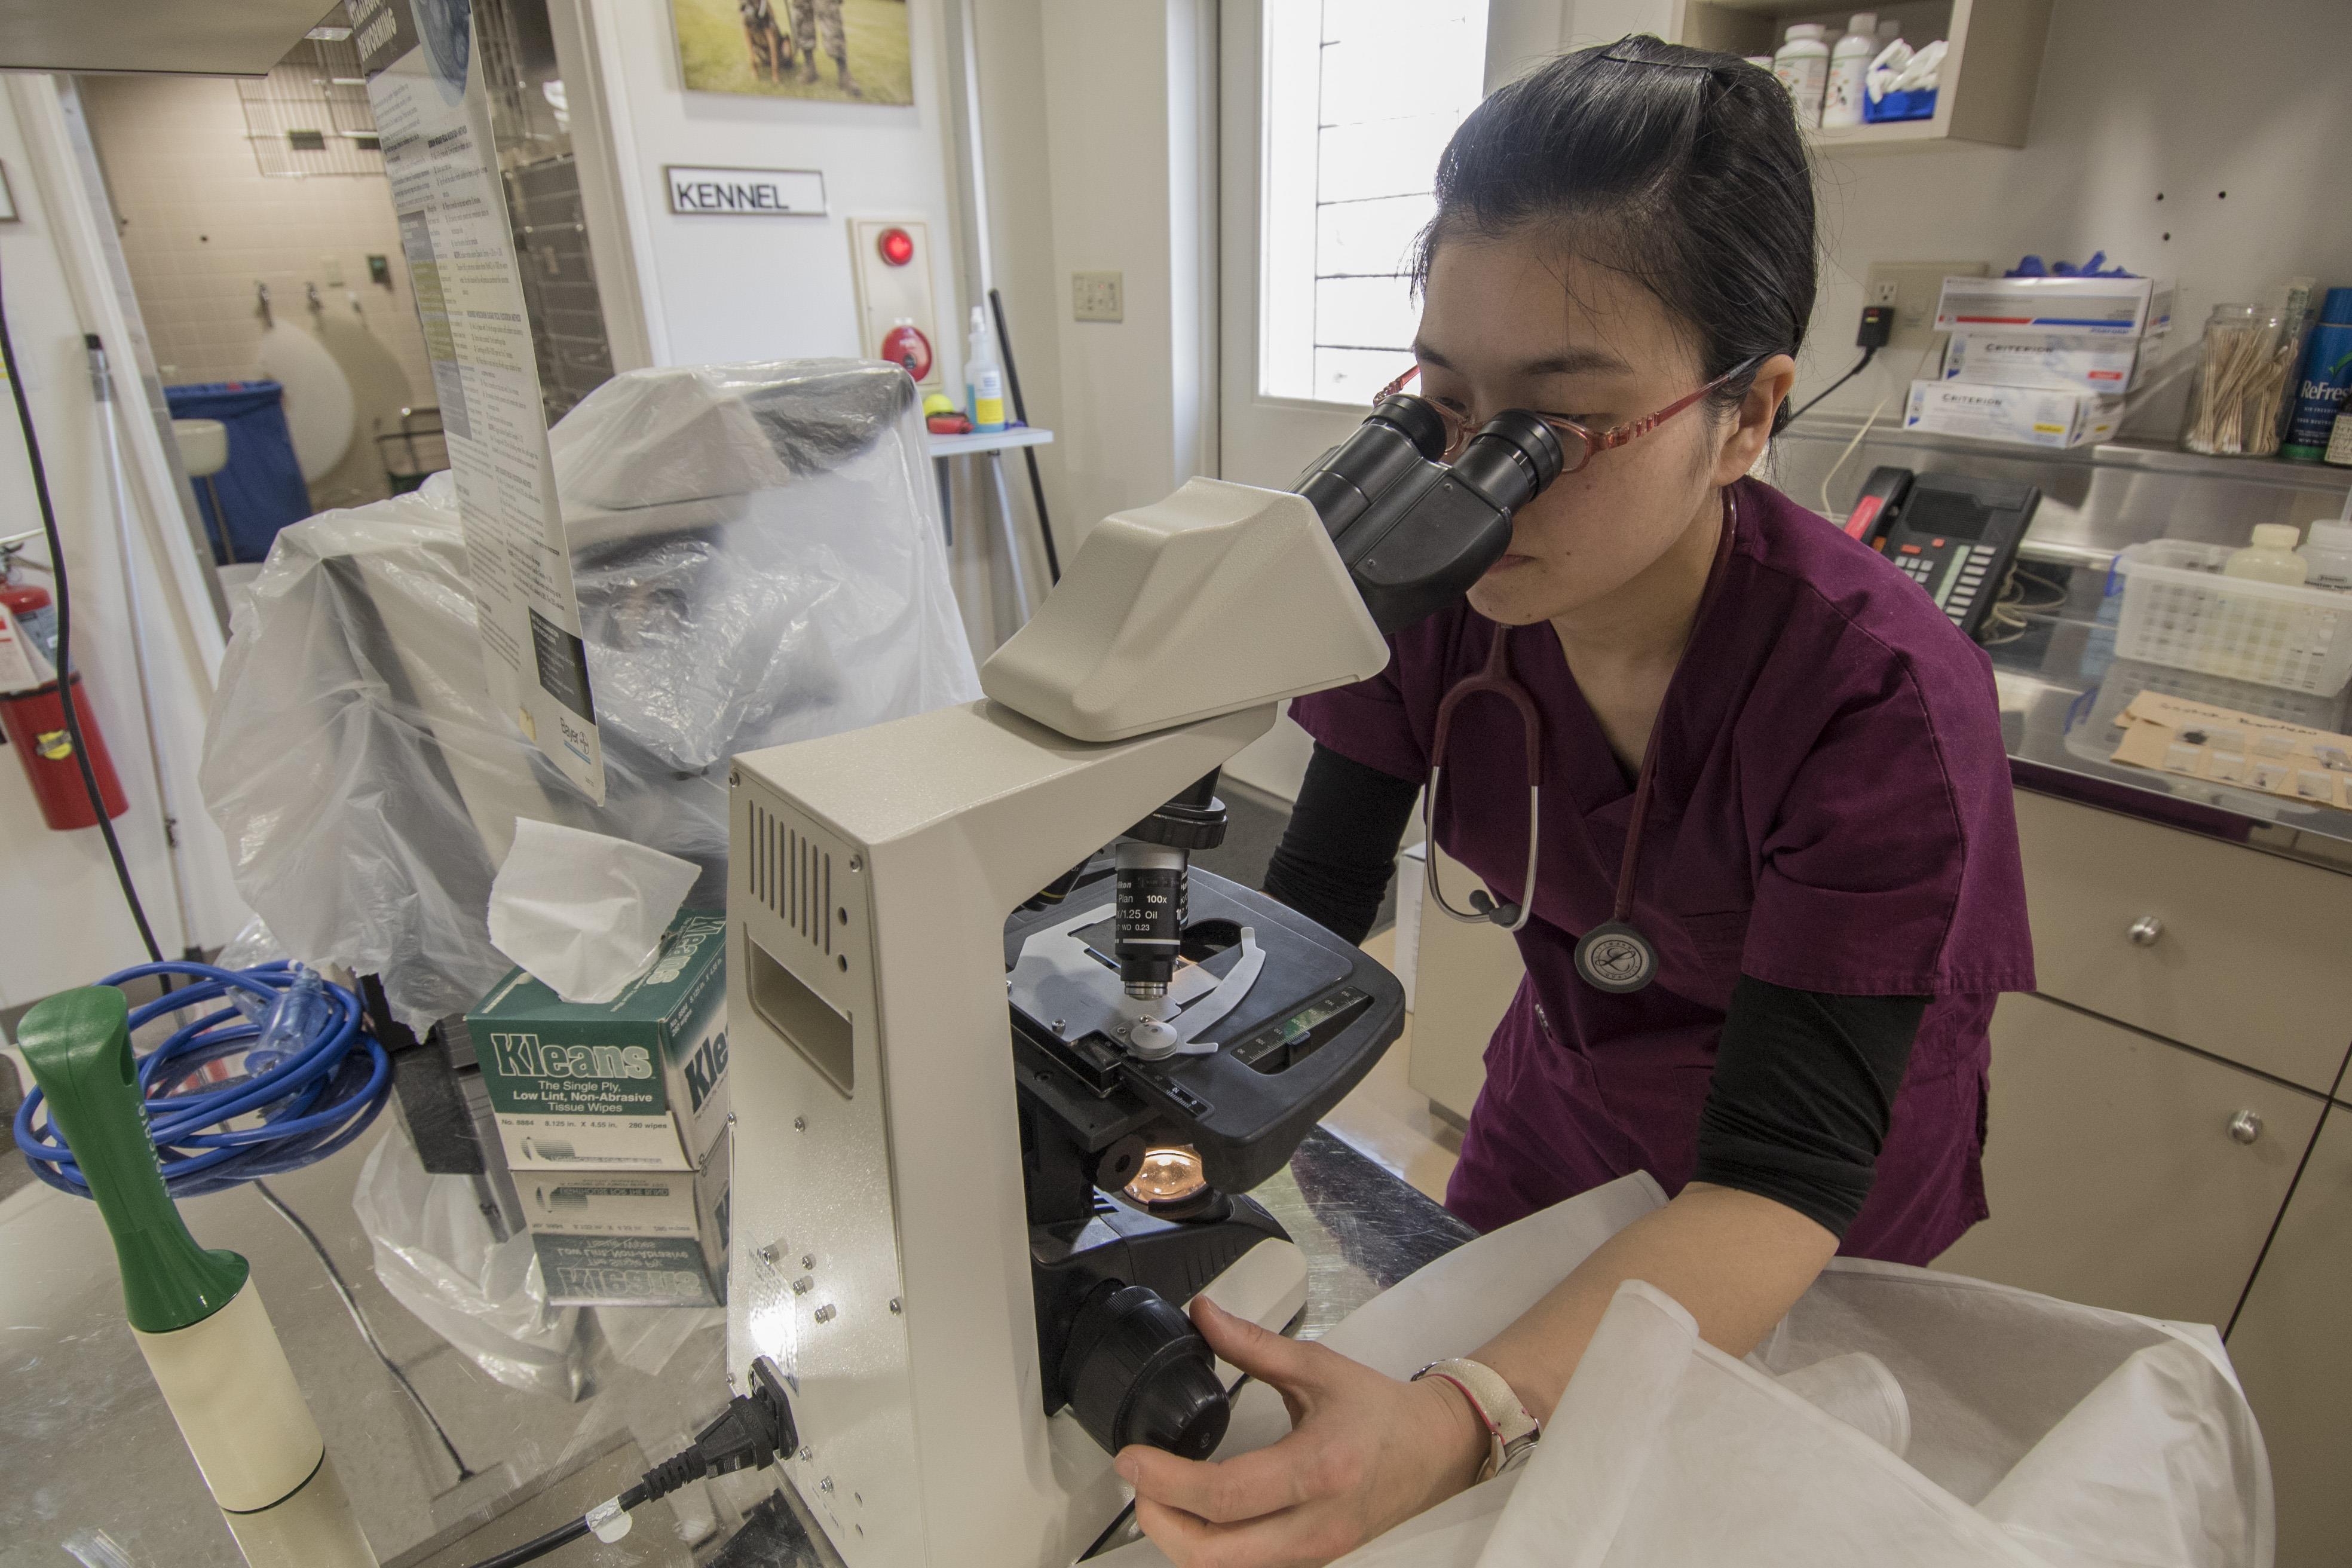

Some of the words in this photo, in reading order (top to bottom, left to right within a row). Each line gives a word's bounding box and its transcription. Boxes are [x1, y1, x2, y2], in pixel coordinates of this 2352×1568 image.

[357, 7, 397, 62] DEWORMING
[676, 183, 789, 209] KENNEL
[1986, 343, 2054, 353] CRITERION
[2300, 380, 2352, 401] ReFres
[1942, 393, 2003, 406] CRITERION
[560, 717, 578, 744] Bayer
[1119, 894, 1133, 903] Plan
[1147, 895, 1167, 904] 100x
[1145, 910, 1157, 919] Oil
[490, 1033, 653, 1080] Kleans
[684, 1024, 728, 1115] Kle
[538, 1080, 560, 1091] The
[563, 1081, 598, 1093] Single
[601, 1082, 621, 1094] Ply,
[513, 1091, 538, 1101] Low
[541, 1091, 568, 1102] Lint,
[571, 1092, 653, 1102] Non-Abrasive
[547, 1102, 584, 1112] Tissue
[587, 1102, 623, 1113] Wipes
[644, 1122, 667, 1131] wipes
